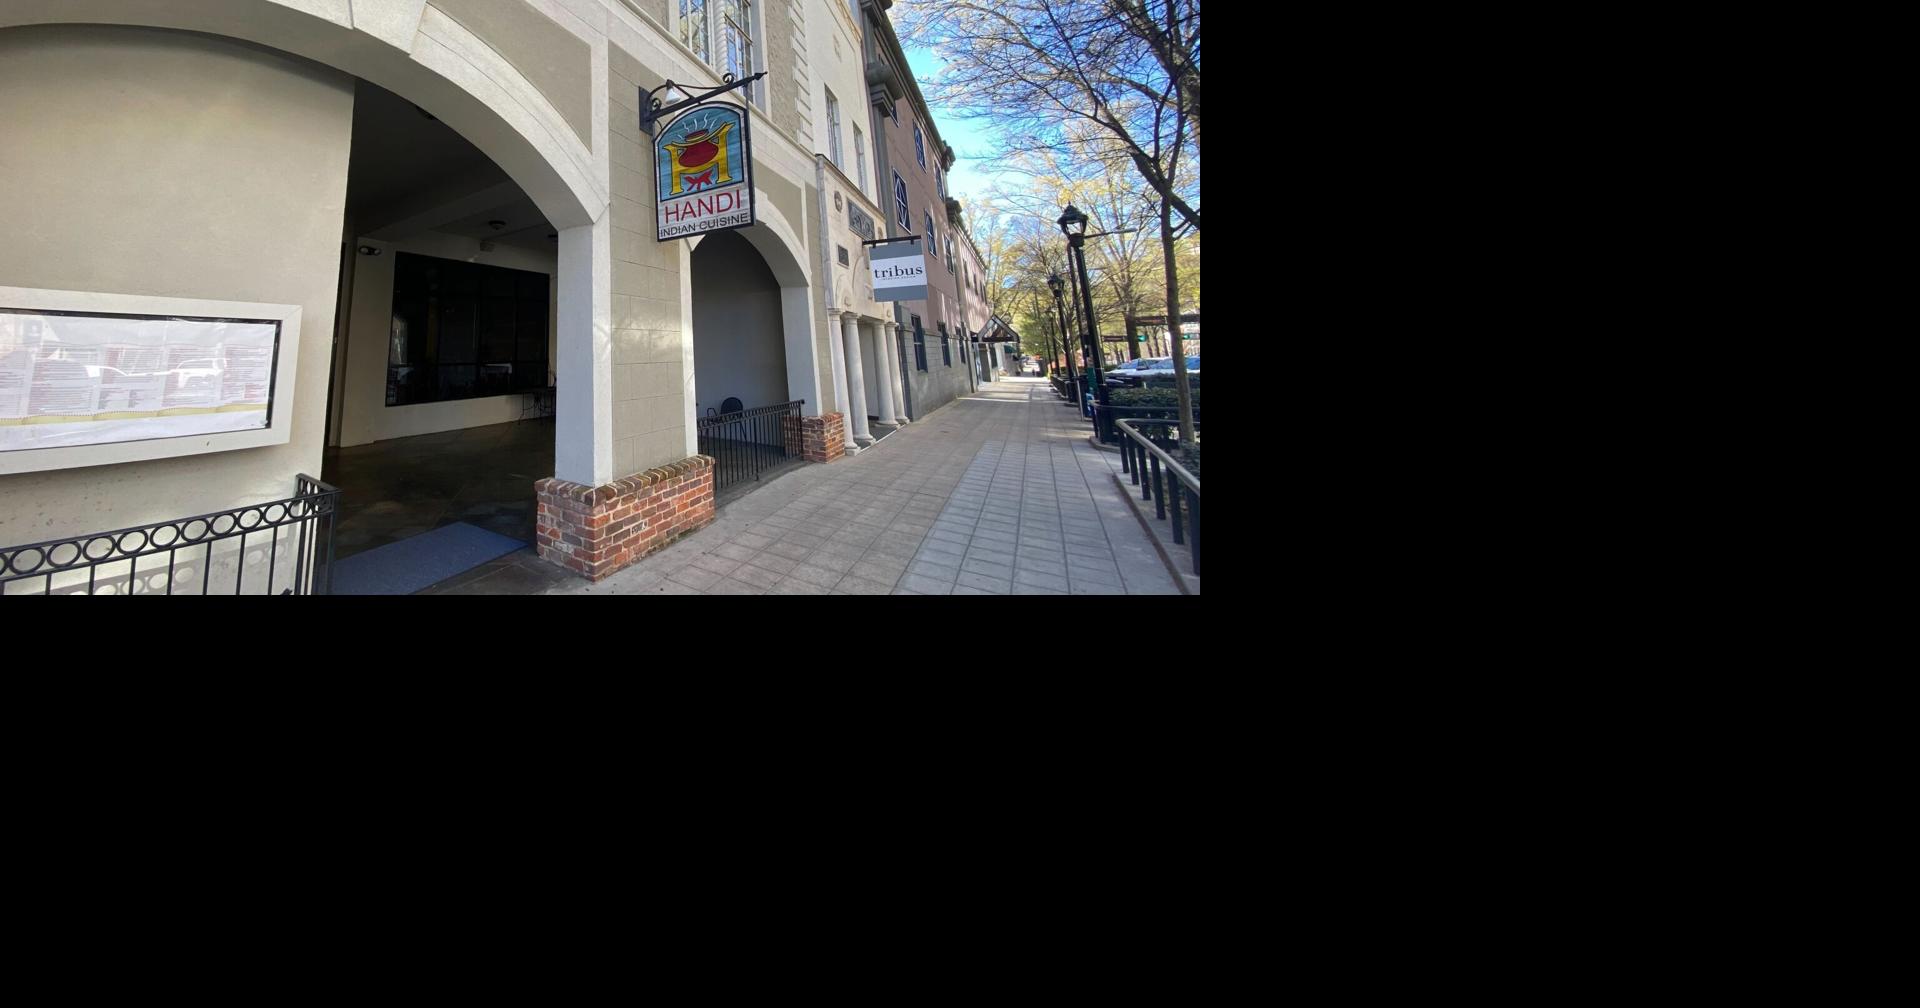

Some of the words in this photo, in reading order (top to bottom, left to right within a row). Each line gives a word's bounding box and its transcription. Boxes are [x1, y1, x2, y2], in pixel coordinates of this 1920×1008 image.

[665, 189, 741, 224] HANDI
[660, 223, 696, 237] INDIAN
[699, 212, 749, 230] CUISINE
[874, 265, 923, 279] tribus
